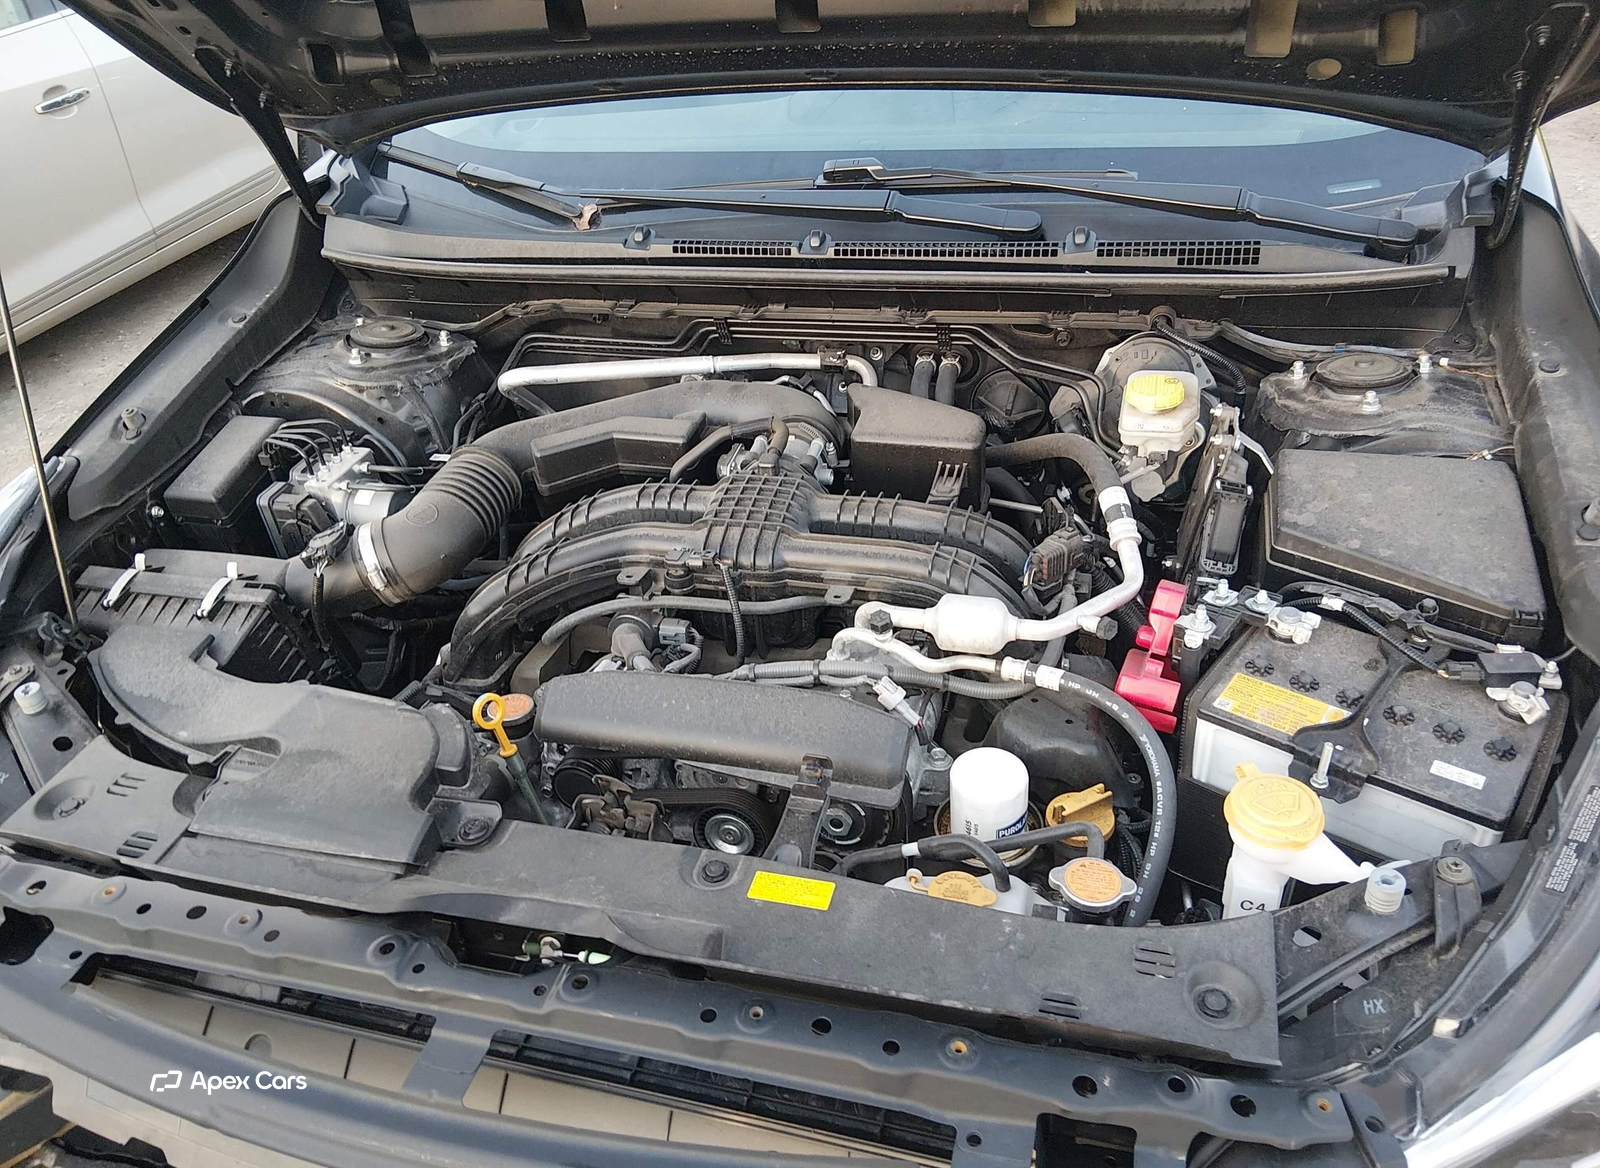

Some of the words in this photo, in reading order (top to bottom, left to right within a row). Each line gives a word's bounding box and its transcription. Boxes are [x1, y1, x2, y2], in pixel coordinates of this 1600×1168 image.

[1237, 674, 1263, 686] DANGER
[1228, 686, 1254, 698] POISON
[1144, 740, 1161, 778] YOKOHAMA
[1240, 900, 1266, 911] C4
[1363, 999, 1386, 1015] HX
